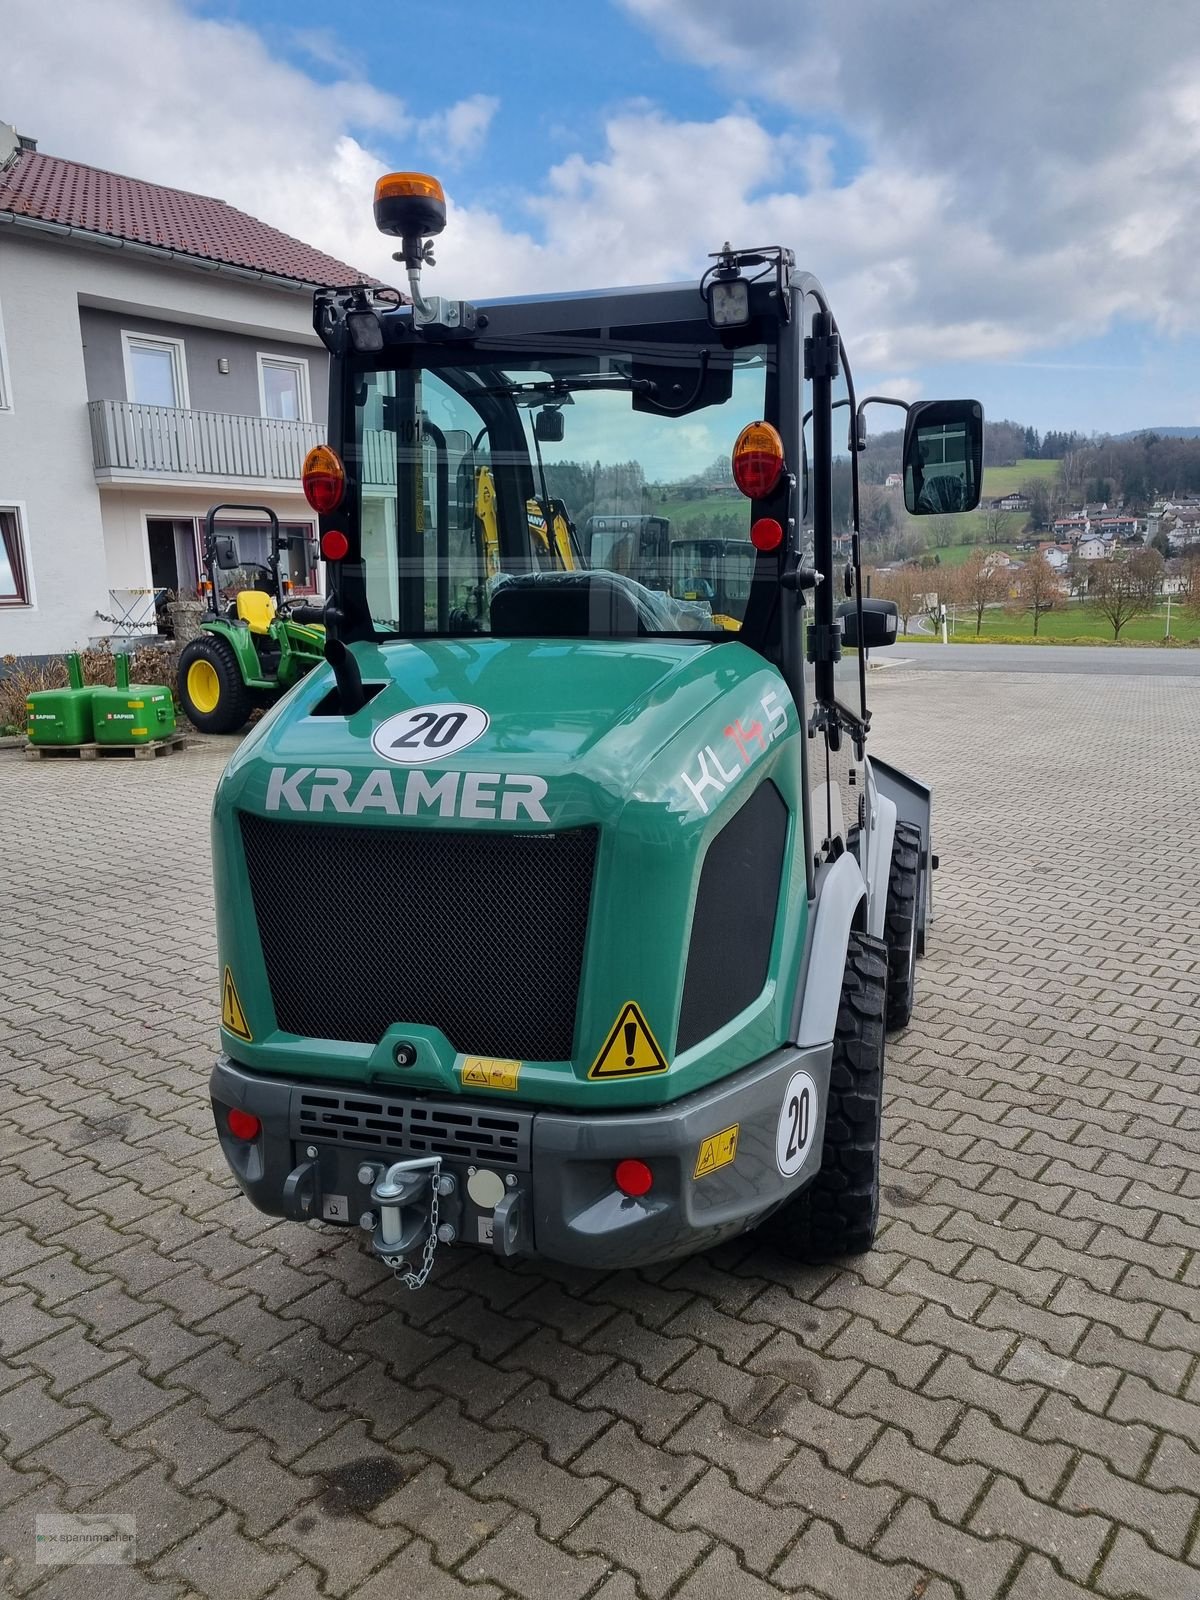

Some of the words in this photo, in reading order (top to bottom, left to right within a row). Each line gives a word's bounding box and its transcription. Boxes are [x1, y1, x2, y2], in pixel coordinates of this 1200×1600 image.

[390, 712, 468, 748] 20
[265, 767, 551, 823] KRAMER
[785, 1087, 810, 1162] 20
